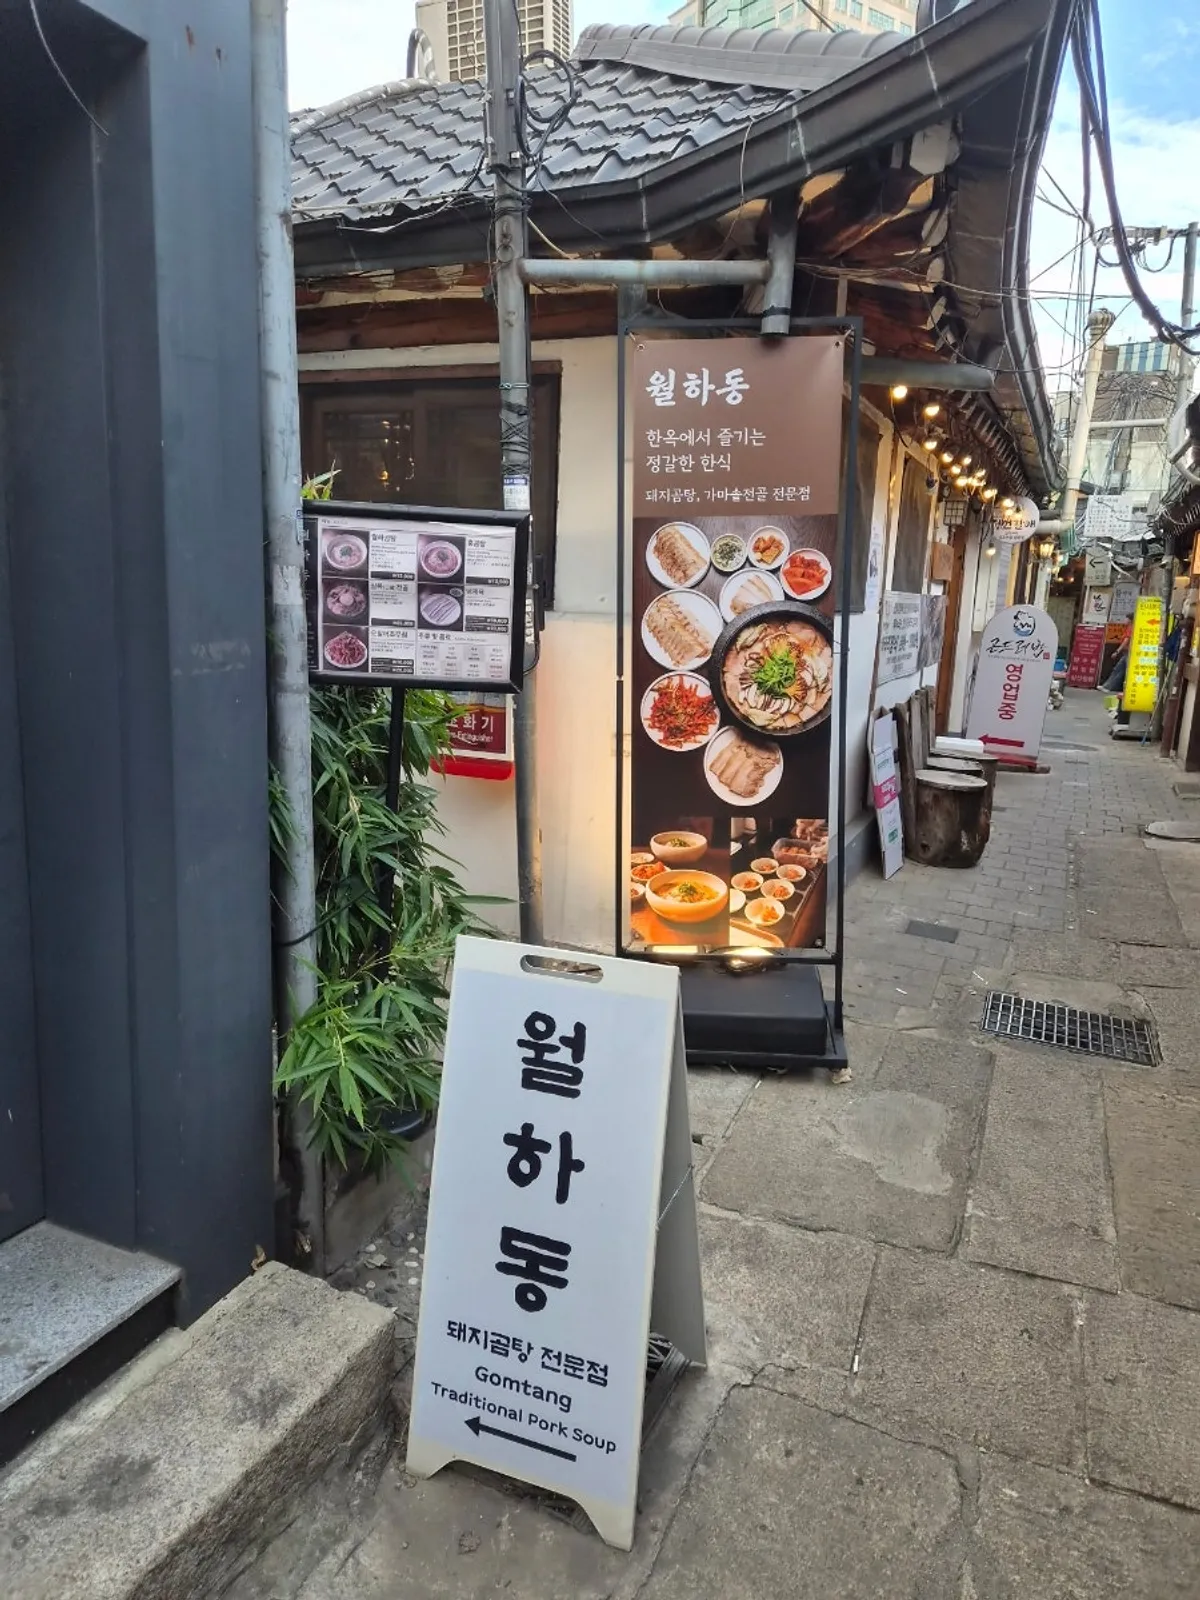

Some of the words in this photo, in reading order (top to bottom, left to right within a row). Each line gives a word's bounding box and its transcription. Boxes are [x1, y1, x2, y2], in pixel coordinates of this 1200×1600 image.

[645, 367, 750, 407] 월하동
[646, 428, 711, 448] 한옥에서
[717, 427, 767, 447] 즐기는
[646, 454, 696, 473] 정갈한
[700, 453, 732, 472] 한식
[645, 488, 700, 503] 돼지곰탕,
[705, 486, 769, 503] 가마솥전골
[772, 485, 811, 501] 전문점
[997, 663, 1024, 720] 영업중
[495, 1010, 587, 1313] 월하동
[447, 1320, 534, 1363] 돼지곰탕
[541, 1347, 609, 1387] 전문점
[474, 1366, 572, 1413] Gomtang
[431, 1381, 523, 1422] Traditional
[528, 1413, 568, 1438] Pork
[572, 1428, 617, 1454] Soup
